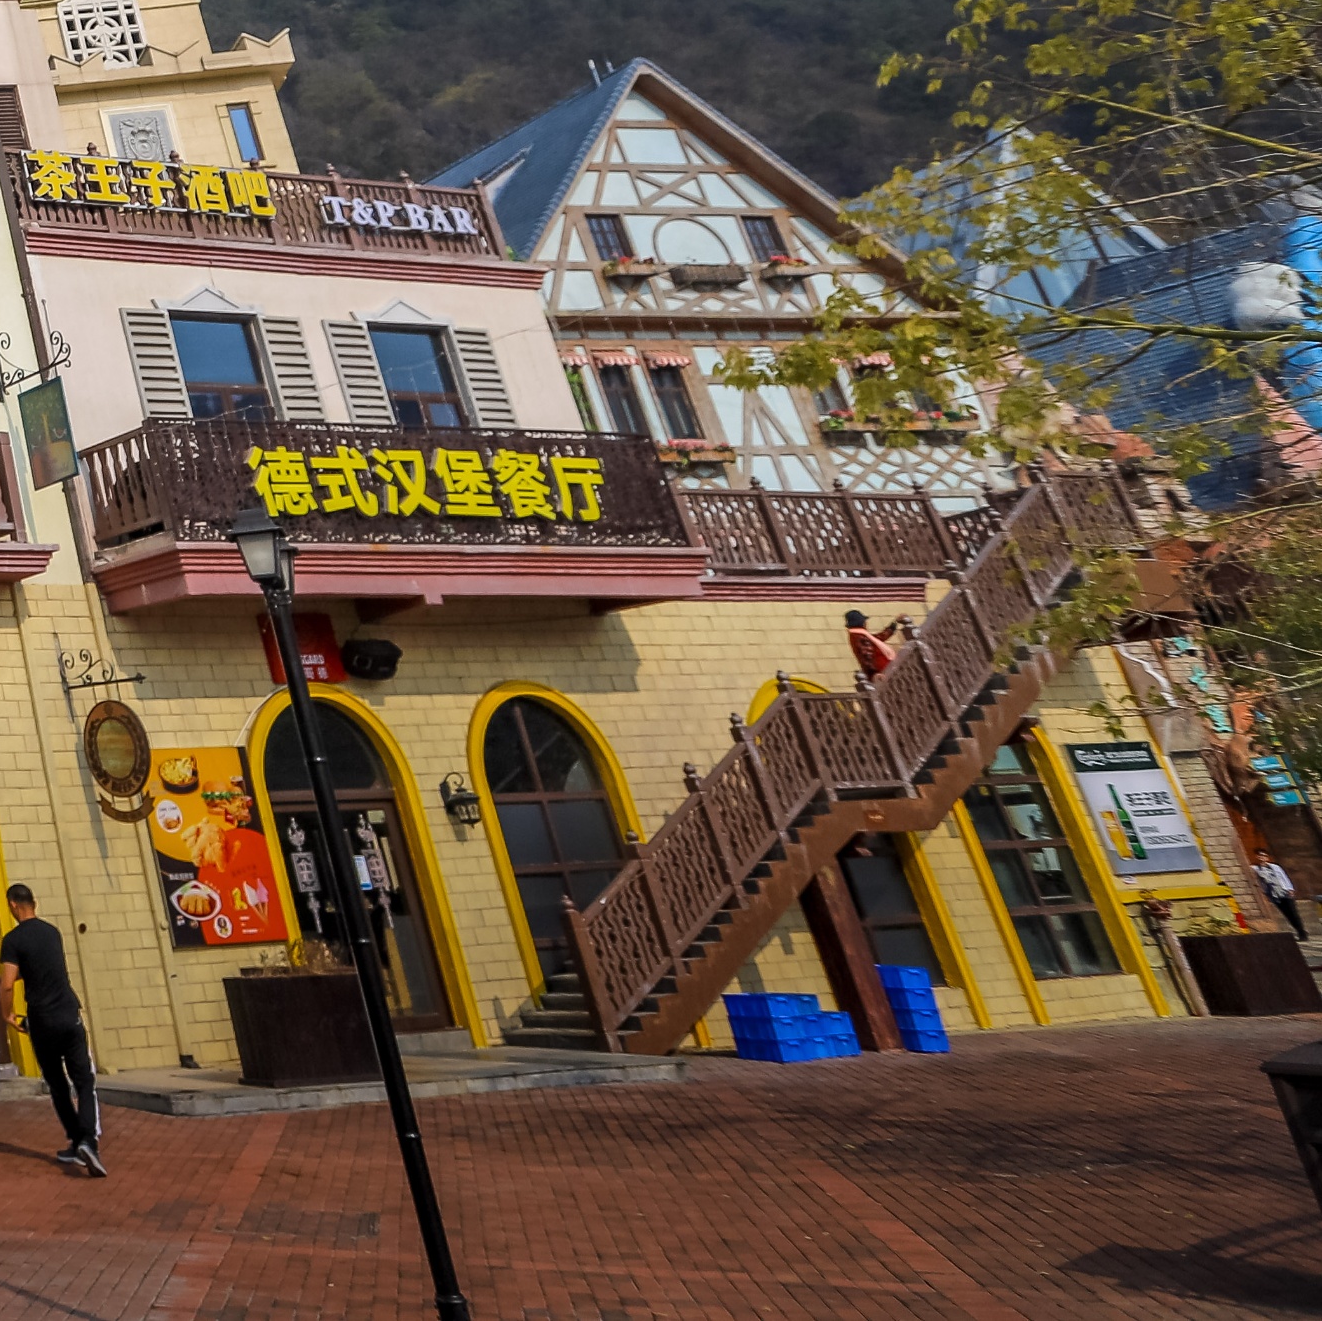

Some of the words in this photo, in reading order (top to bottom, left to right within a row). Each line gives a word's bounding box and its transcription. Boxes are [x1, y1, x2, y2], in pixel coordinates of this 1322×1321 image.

[26, 150, 277, 216] 茶王子酒吧
[322, 195, 396, 228] T&P
[402, 202, 479, 234] BAR
[247, 445, 605, 522] 德式汉堡餐厅
